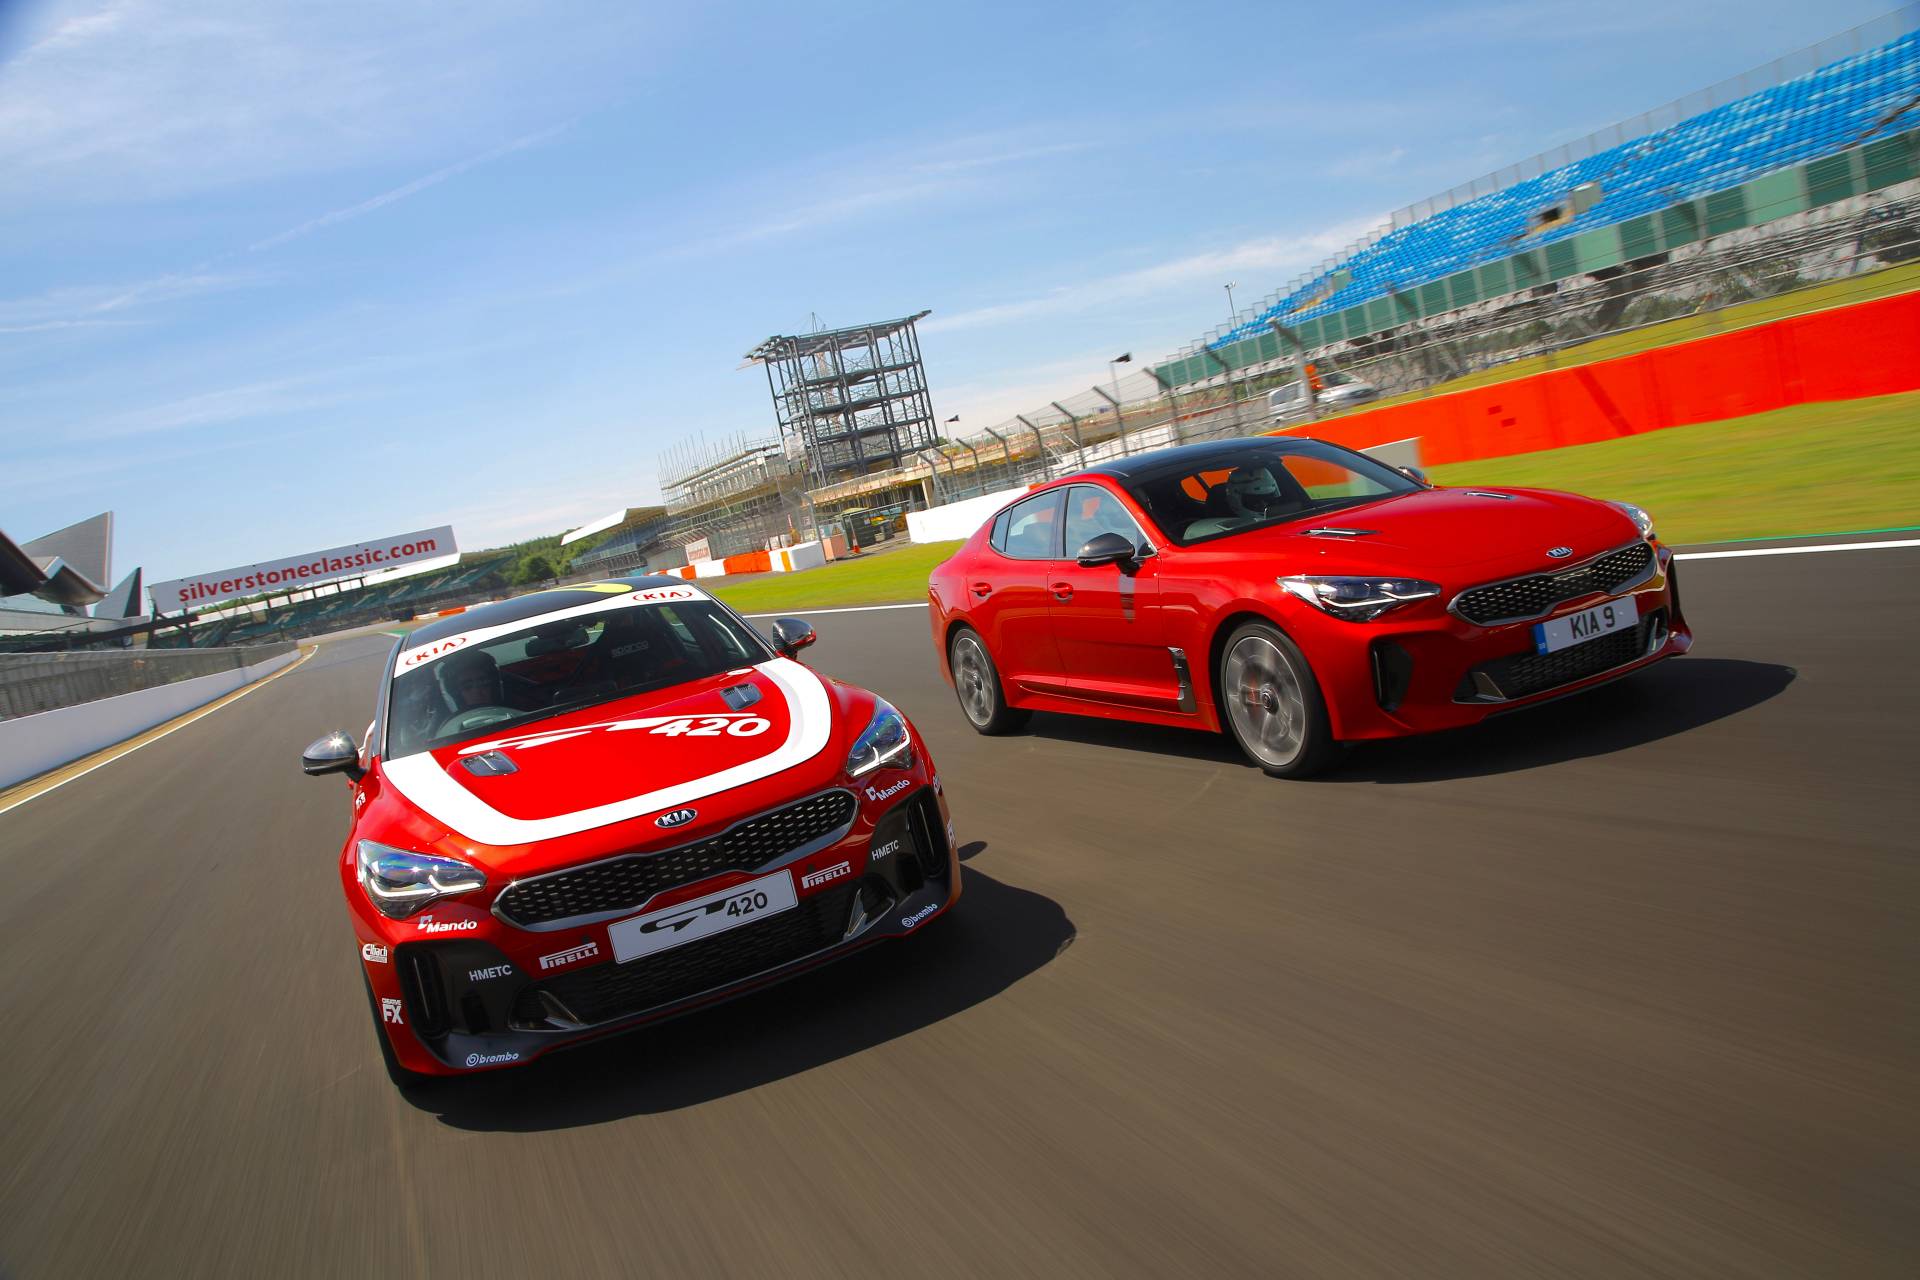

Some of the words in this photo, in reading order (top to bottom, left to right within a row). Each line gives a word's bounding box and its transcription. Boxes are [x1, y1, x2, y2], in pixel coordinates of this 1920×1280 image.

[178, 538, 437, 602] silverstoneclassic.com
[643, 590, 684, 600] KIA
[1569, 610, 1601, 639] KIA
[1603, 606, 1616, 628] 9
[415, 638, 458, 662] KIA
[649, 717, 771, 737] 420
[875, 779, 911, 801] Mando
[660, 808, 693, 826] KIA
[871, 839, 900, 861] HMETC
[801, 860, 851, 889] PIRELLI
[726, 892, 768, 917] 420
[911, 903, 938, 923] brembo
[426, 919, 478, 934] Mando
[539, 941, 599, 970] PIRELLI
[468, 964, 513, 982] HMETC
[478, 1051, 520, 1065] brembo
